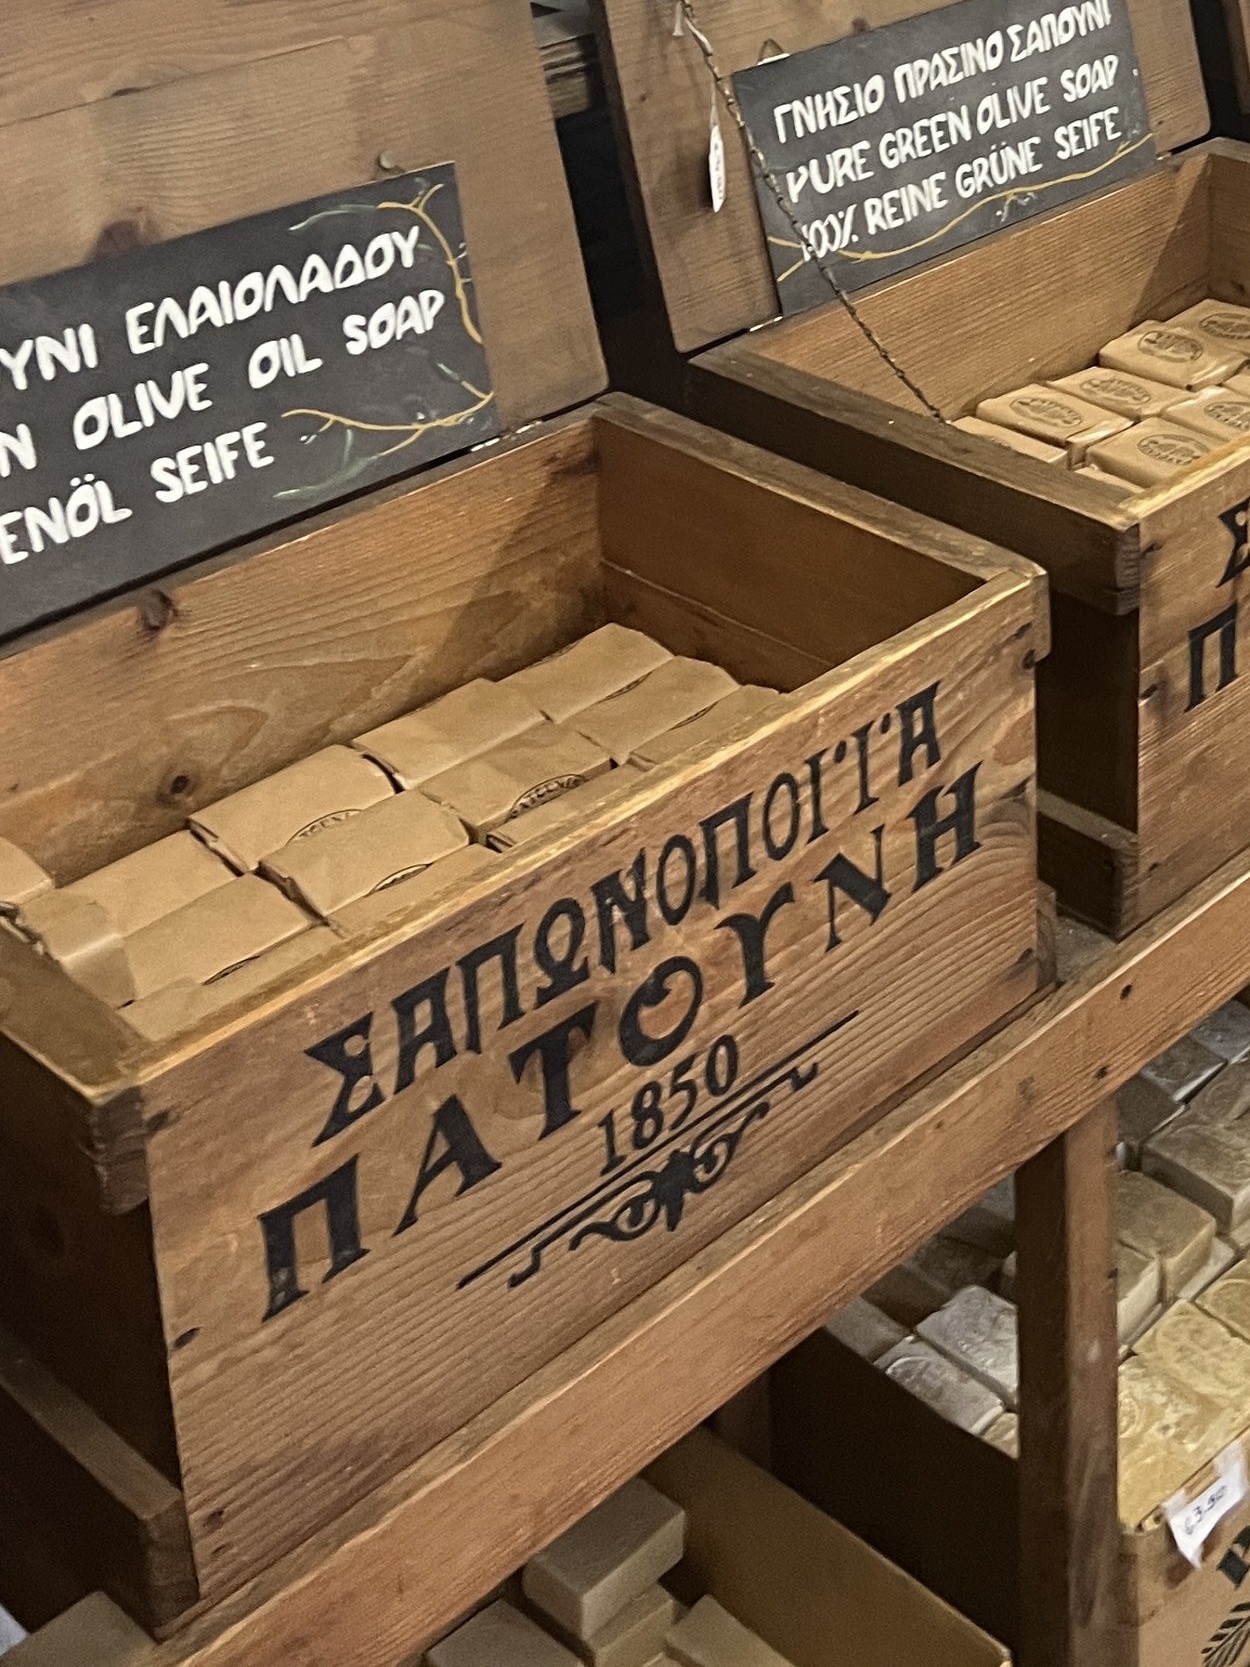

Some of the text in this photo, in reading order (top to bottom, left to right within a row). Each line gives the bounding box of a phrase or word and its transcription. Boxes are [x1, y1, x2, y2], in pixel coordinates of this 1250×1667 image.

[773, 74, 885, 144] ΓΝΗΣΙΟ
[893, 30, 1005, 103] ΠΡΑΣΙΝΟ
[786, 140, 875, 203] PURE
[878, 104, 972, 169] GREEN
[975, 76, 1051, 136] OLIVE
[1059, 54, 1120, 104] SOAP
[864, 171, 949, 235] REINE
[954, 135, 1043, 200] GRÜNE
[1053, 106, 1123, 161] SEIFE
[125, 225, 420, 356] ΕΛΑΙΟΛΑΔΟΥ
[72, 362, 213, 450] OLIVE
[247, 334, 323, 390] OIL
[342, 289, 446, 356] SOAP
[150, 421, 275, 503] SEIFE
[258, 761, 984, 1323] ΠΑΤΟΥΝΗ
[597, 1033, 739, 1175] 1850
